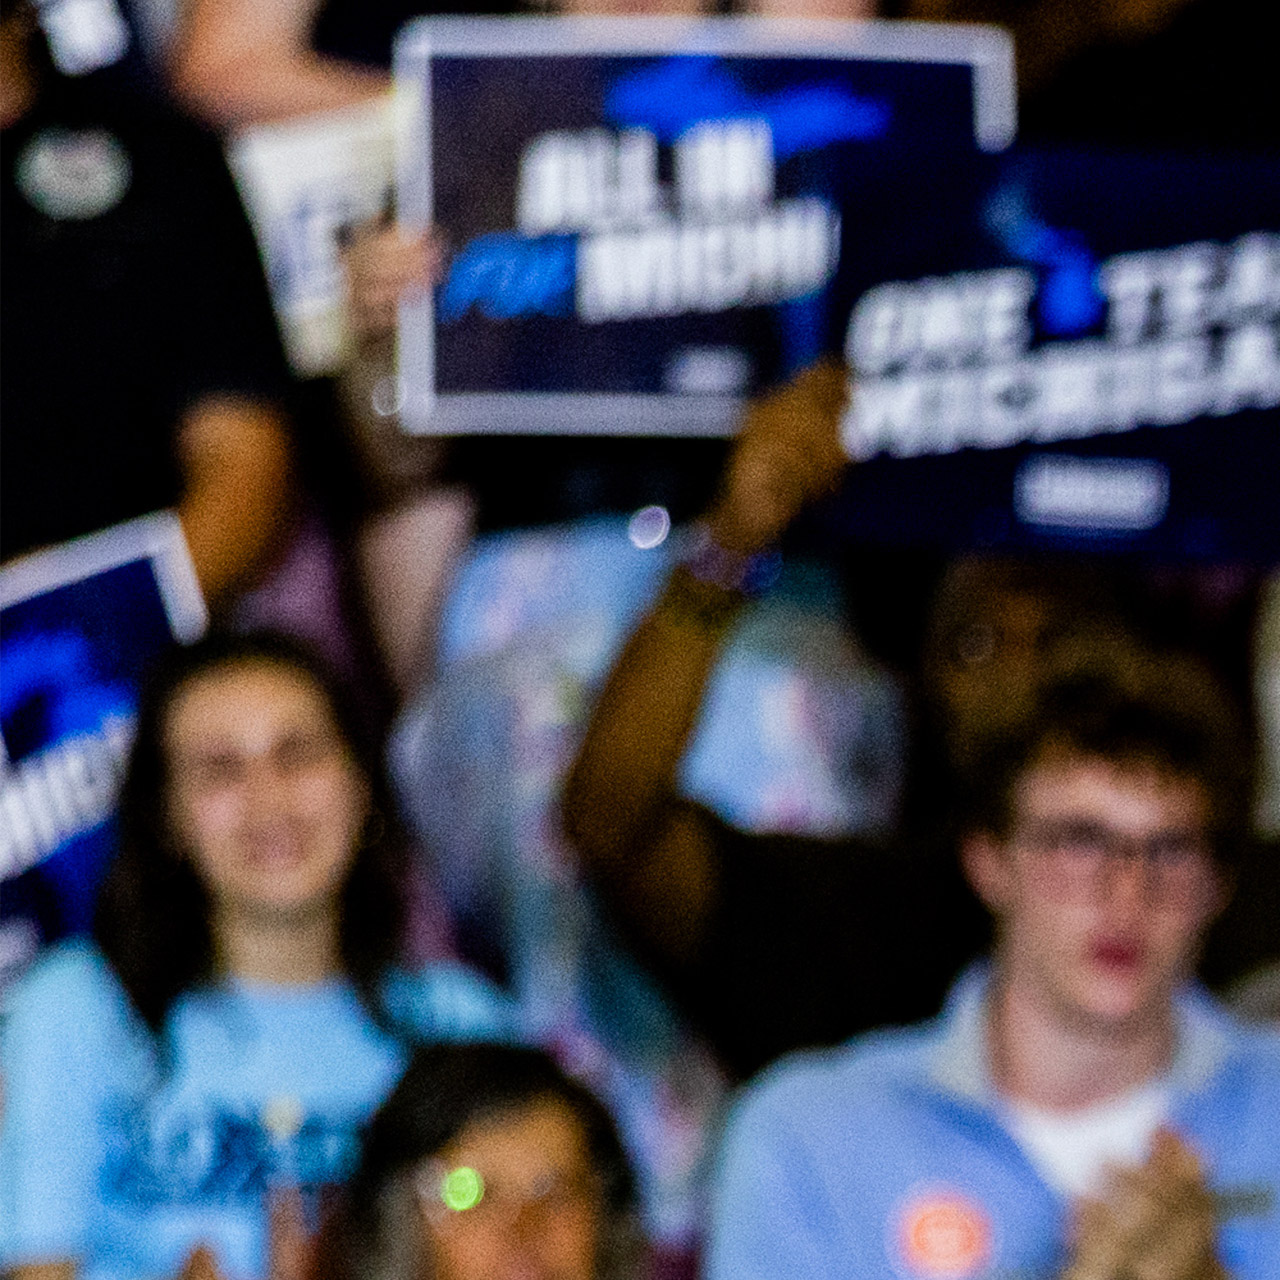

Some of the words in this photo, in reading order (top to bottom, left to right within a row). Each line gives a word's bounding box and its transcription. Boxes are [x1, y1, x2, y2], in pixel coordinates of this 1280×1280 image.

[519, 130, 661, 238] ALL
[676, 120, 775, 208] IN
[576, 200, 842, 322] MICHI
[848, 268, 1034, 374] ONE
